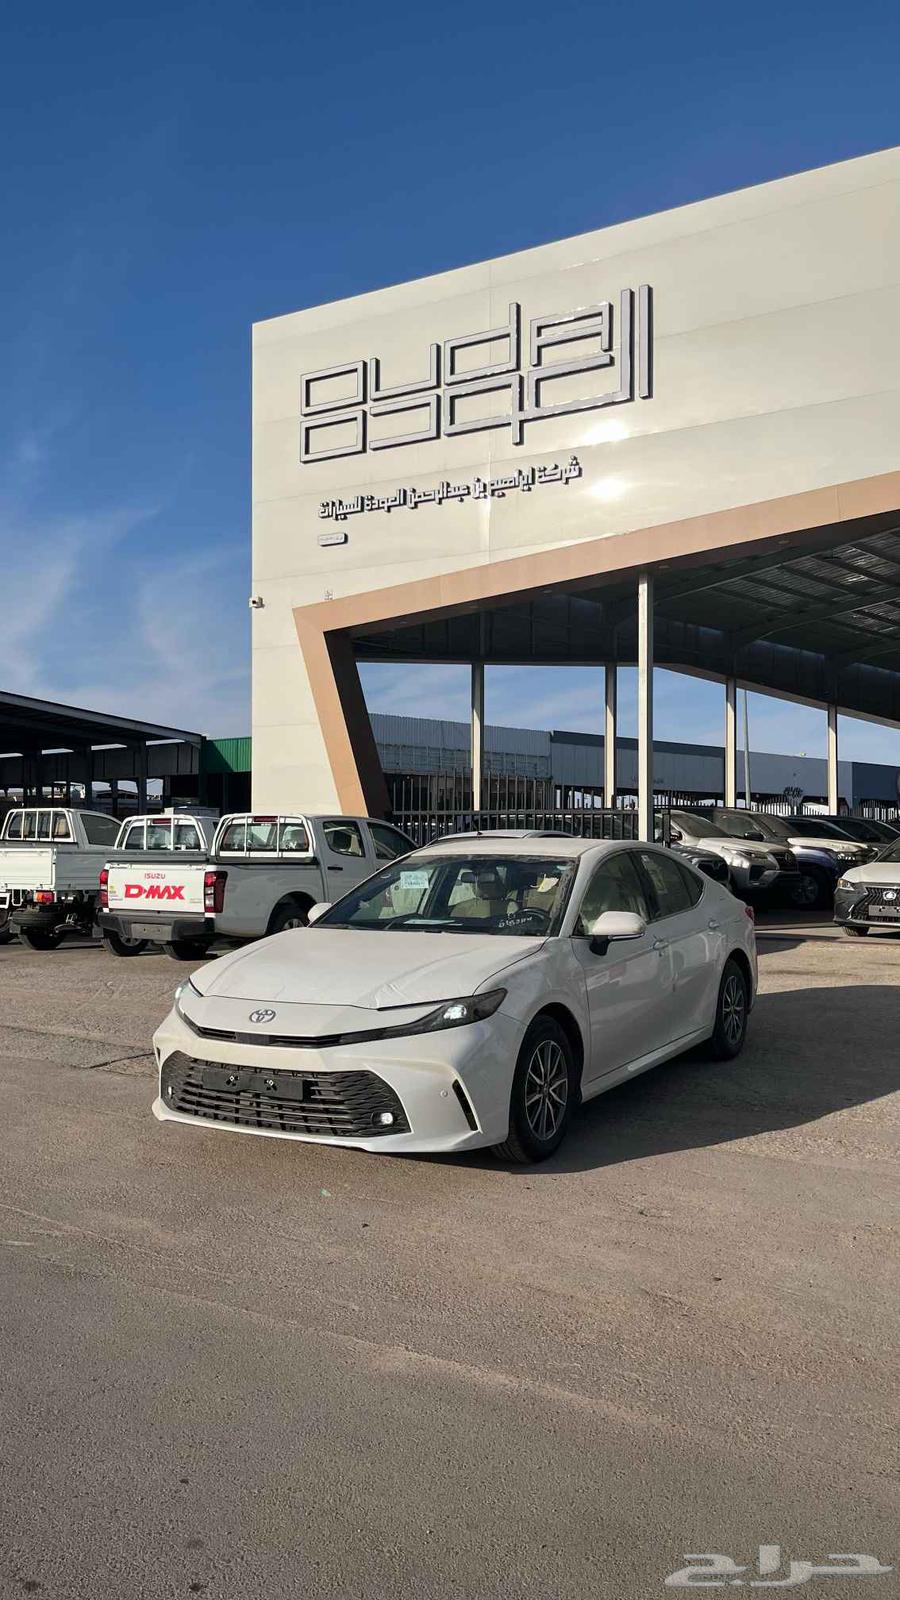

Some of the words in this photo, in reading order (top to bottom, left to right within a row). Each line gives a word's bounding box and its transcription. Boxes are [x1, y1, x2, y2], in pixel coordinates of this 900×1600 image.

[537, 455, 583, 485] شركة
[365, 488, 407, 513] العودة
[472, 477, 488, 500] بن
[318, 495, 365, 521] للسيارات
[144, 872, 166, 880] ISUZU
[124, 884, 186, 900] D-MAX
